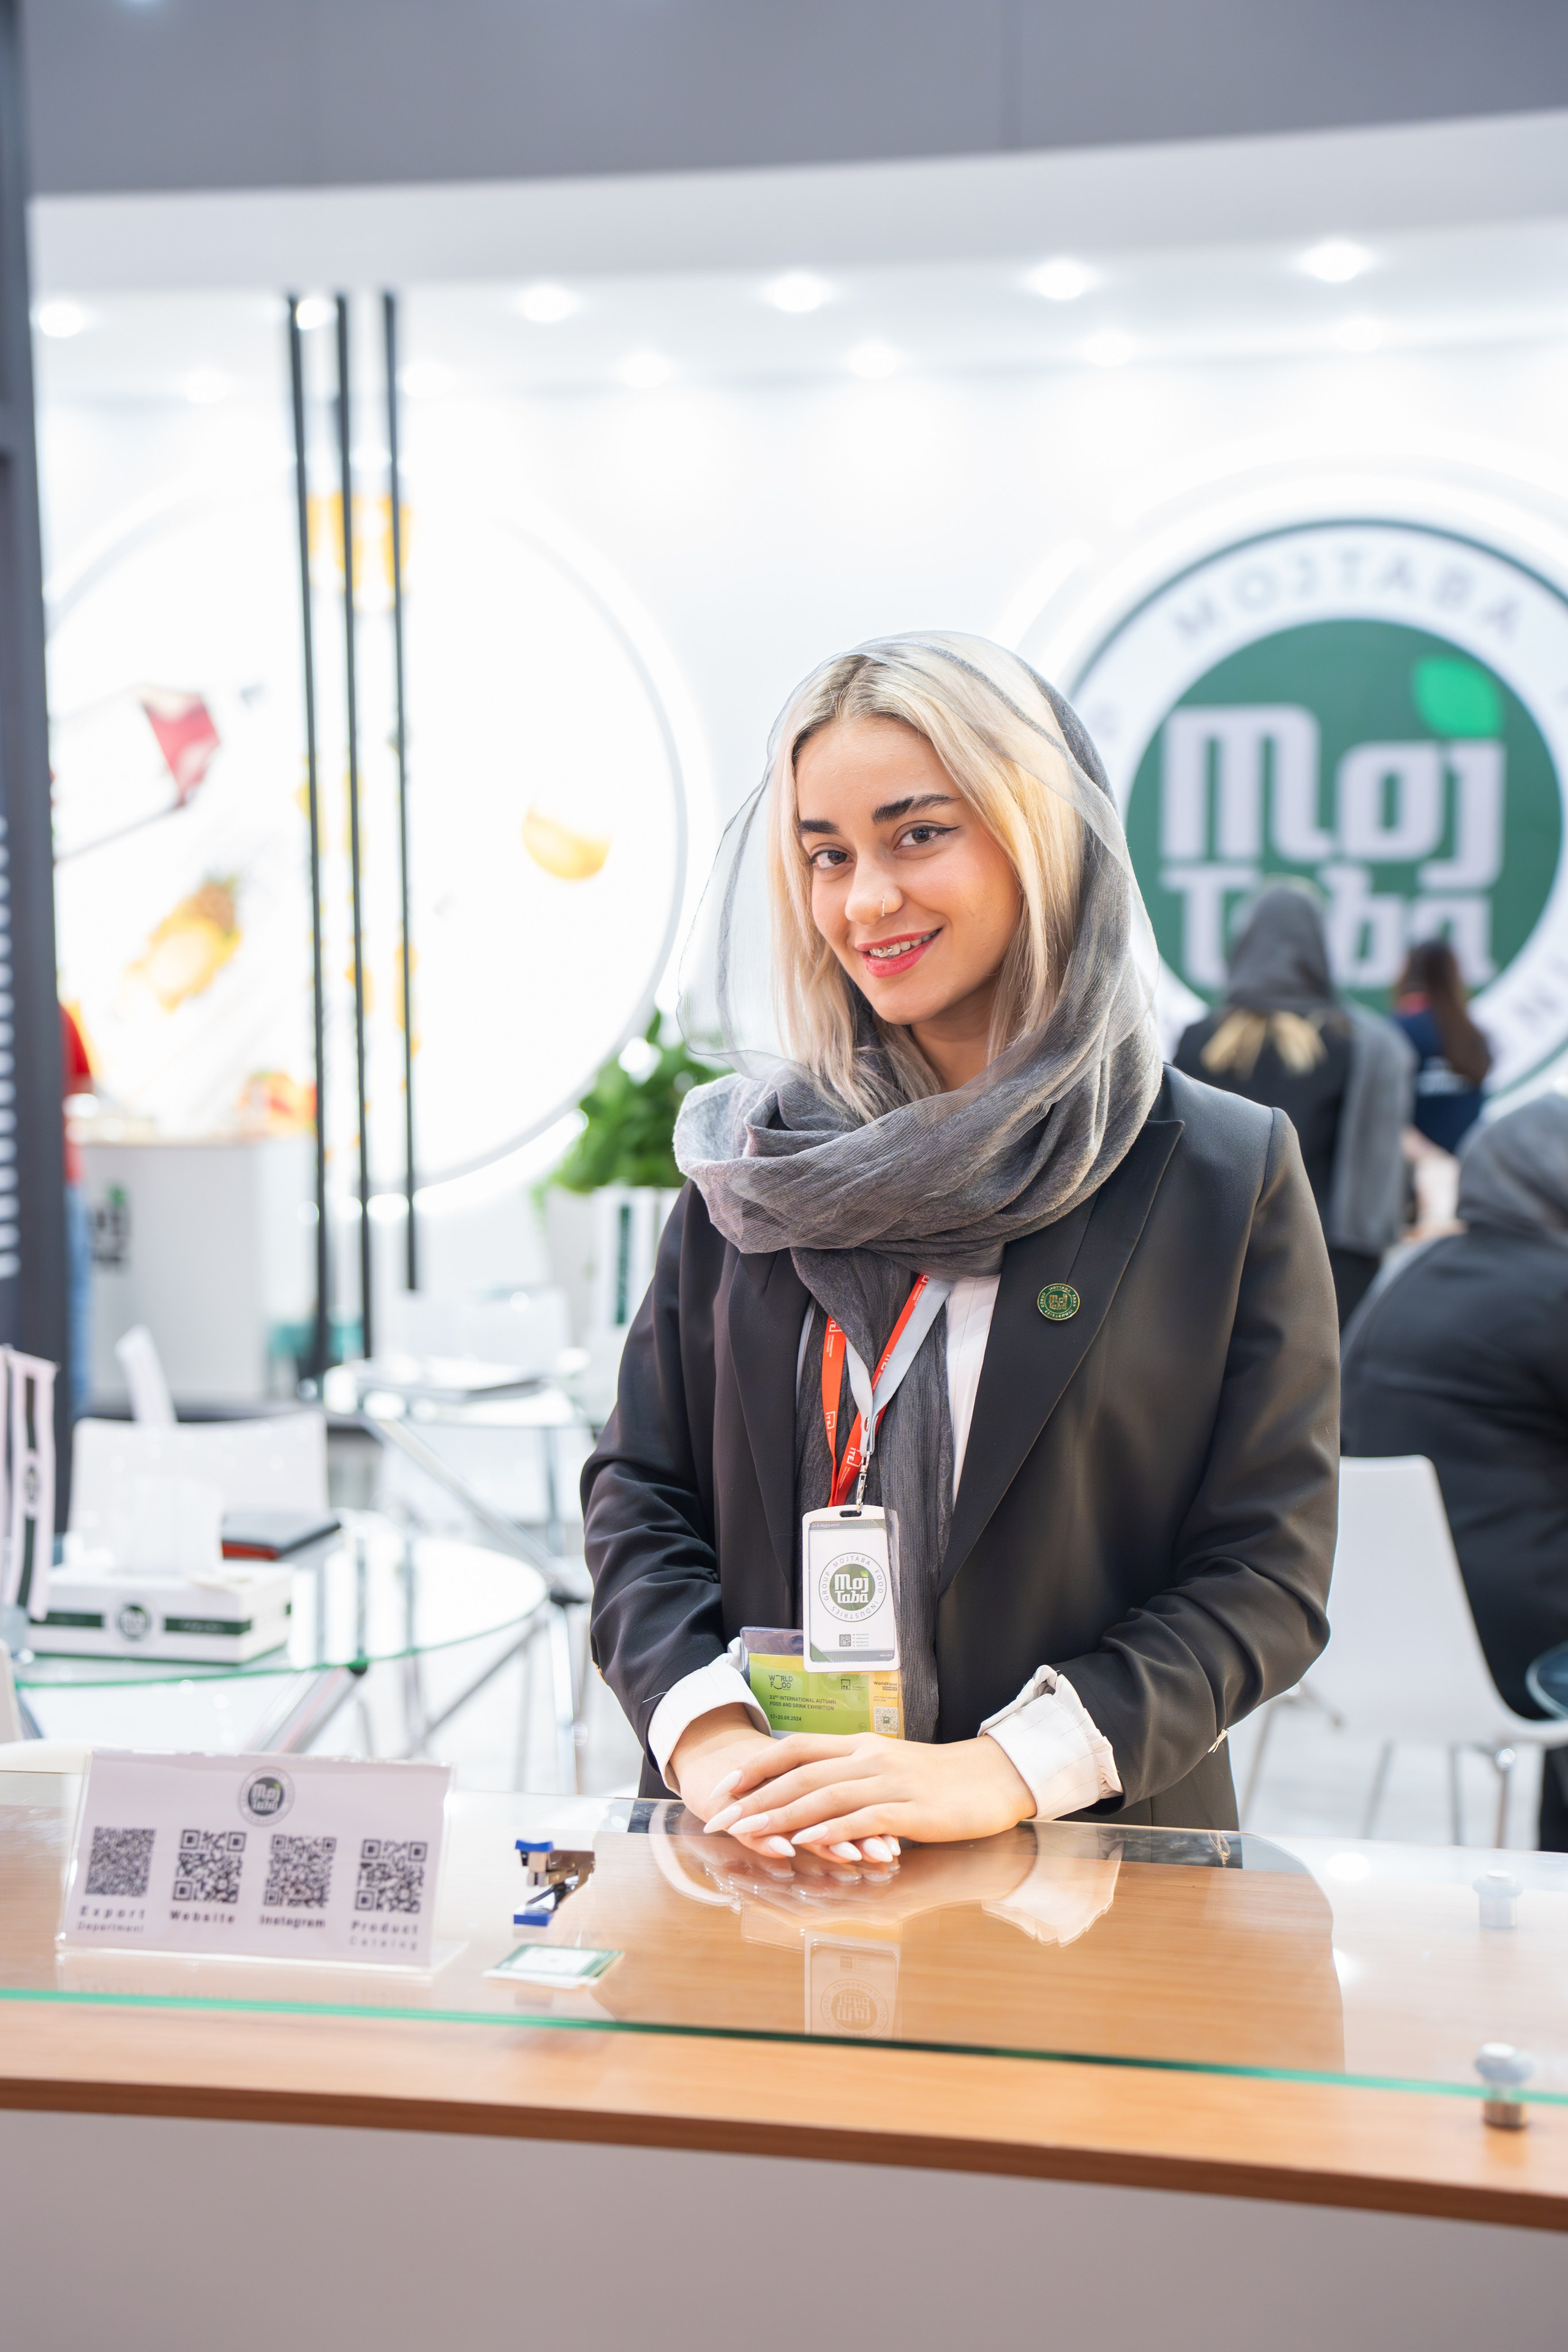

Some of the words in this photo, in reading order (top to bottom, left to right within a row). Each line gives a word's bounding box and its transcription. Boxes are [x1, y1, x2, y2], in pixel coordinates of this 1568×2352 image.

[846, 1447, 856, 1462] ITE
[832, 1556, 870, 1567] MOJTABA
[834, 1574, 869, 1593] Moj
[874, 1570, 884, 1593] FOOD
[834, 1590, 869, 1604] Taba
[831, 1600, 878, 1619] INDUSTRIES
[80, 1905, 146, 1919] Export
[170, 1909, 236, 1924] Website
[77, 1921, 144, 1933] Department
[260, 1914, 326, 1928] Instagram
[352, 1920, 419, 1935] Product
